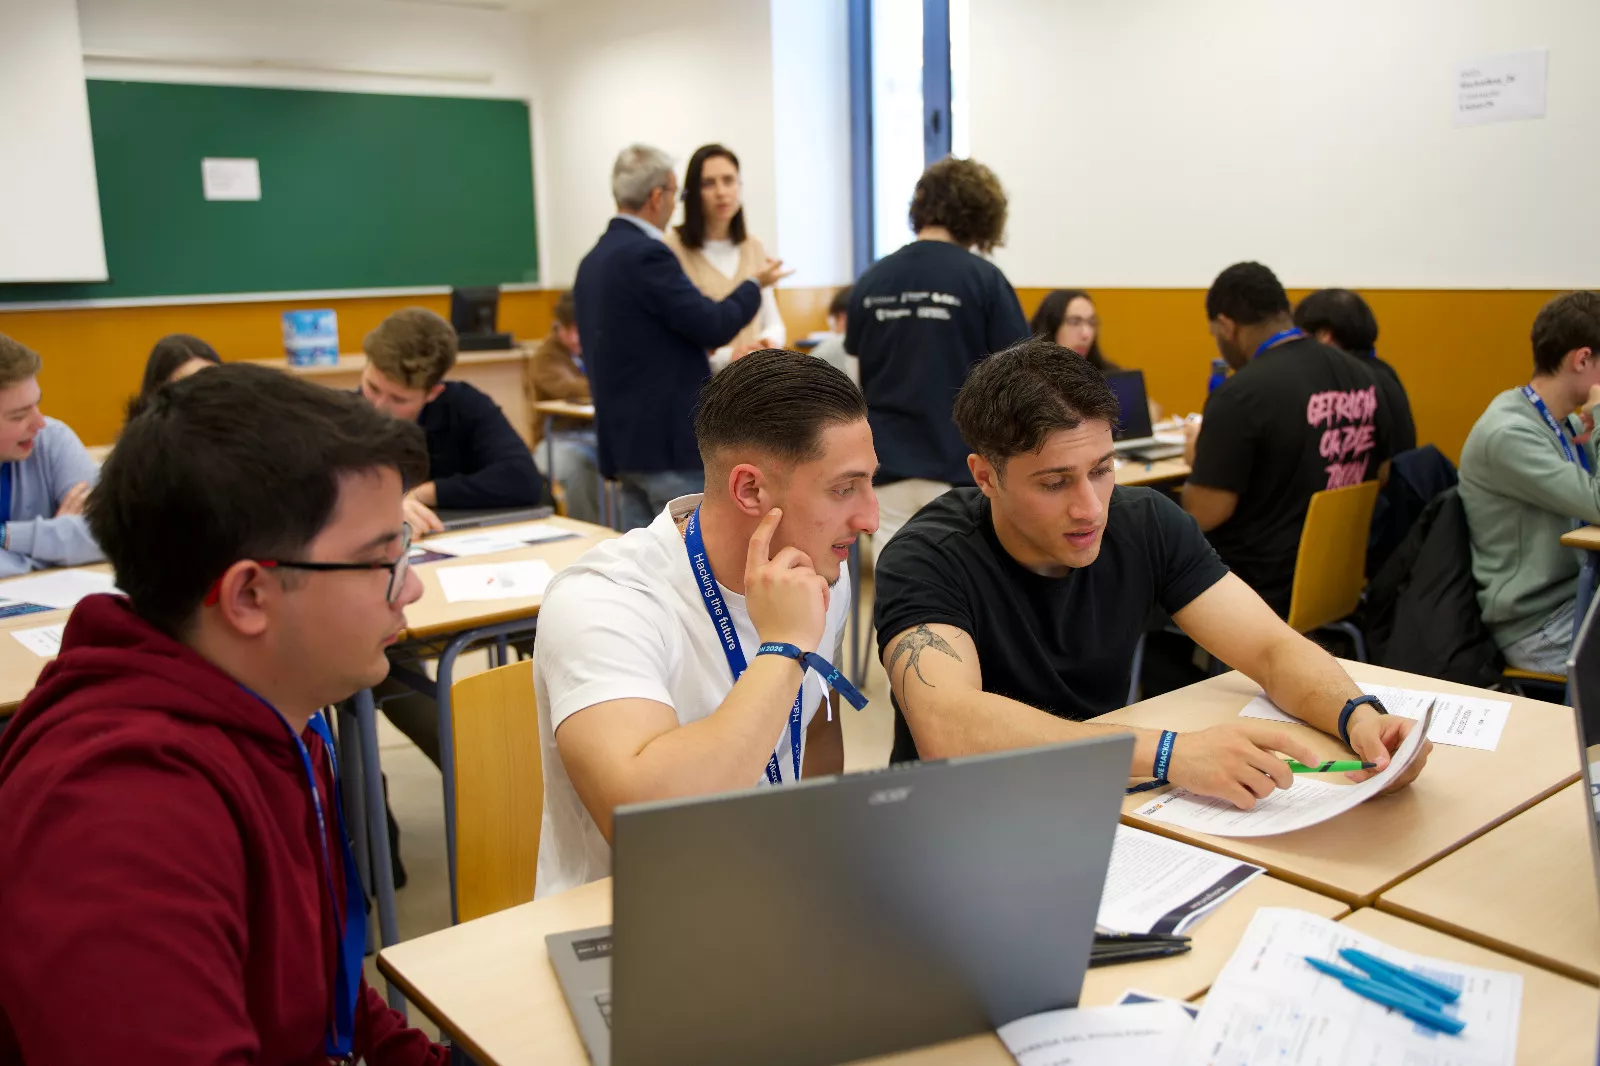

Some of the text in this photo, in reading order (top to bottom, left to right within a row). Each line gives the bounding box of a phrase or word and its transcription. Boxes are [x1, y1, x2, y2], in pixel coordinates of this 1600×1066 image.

[694, 553, 736, 651] Hacking the future
[765, 645, 784, 653] 2026
